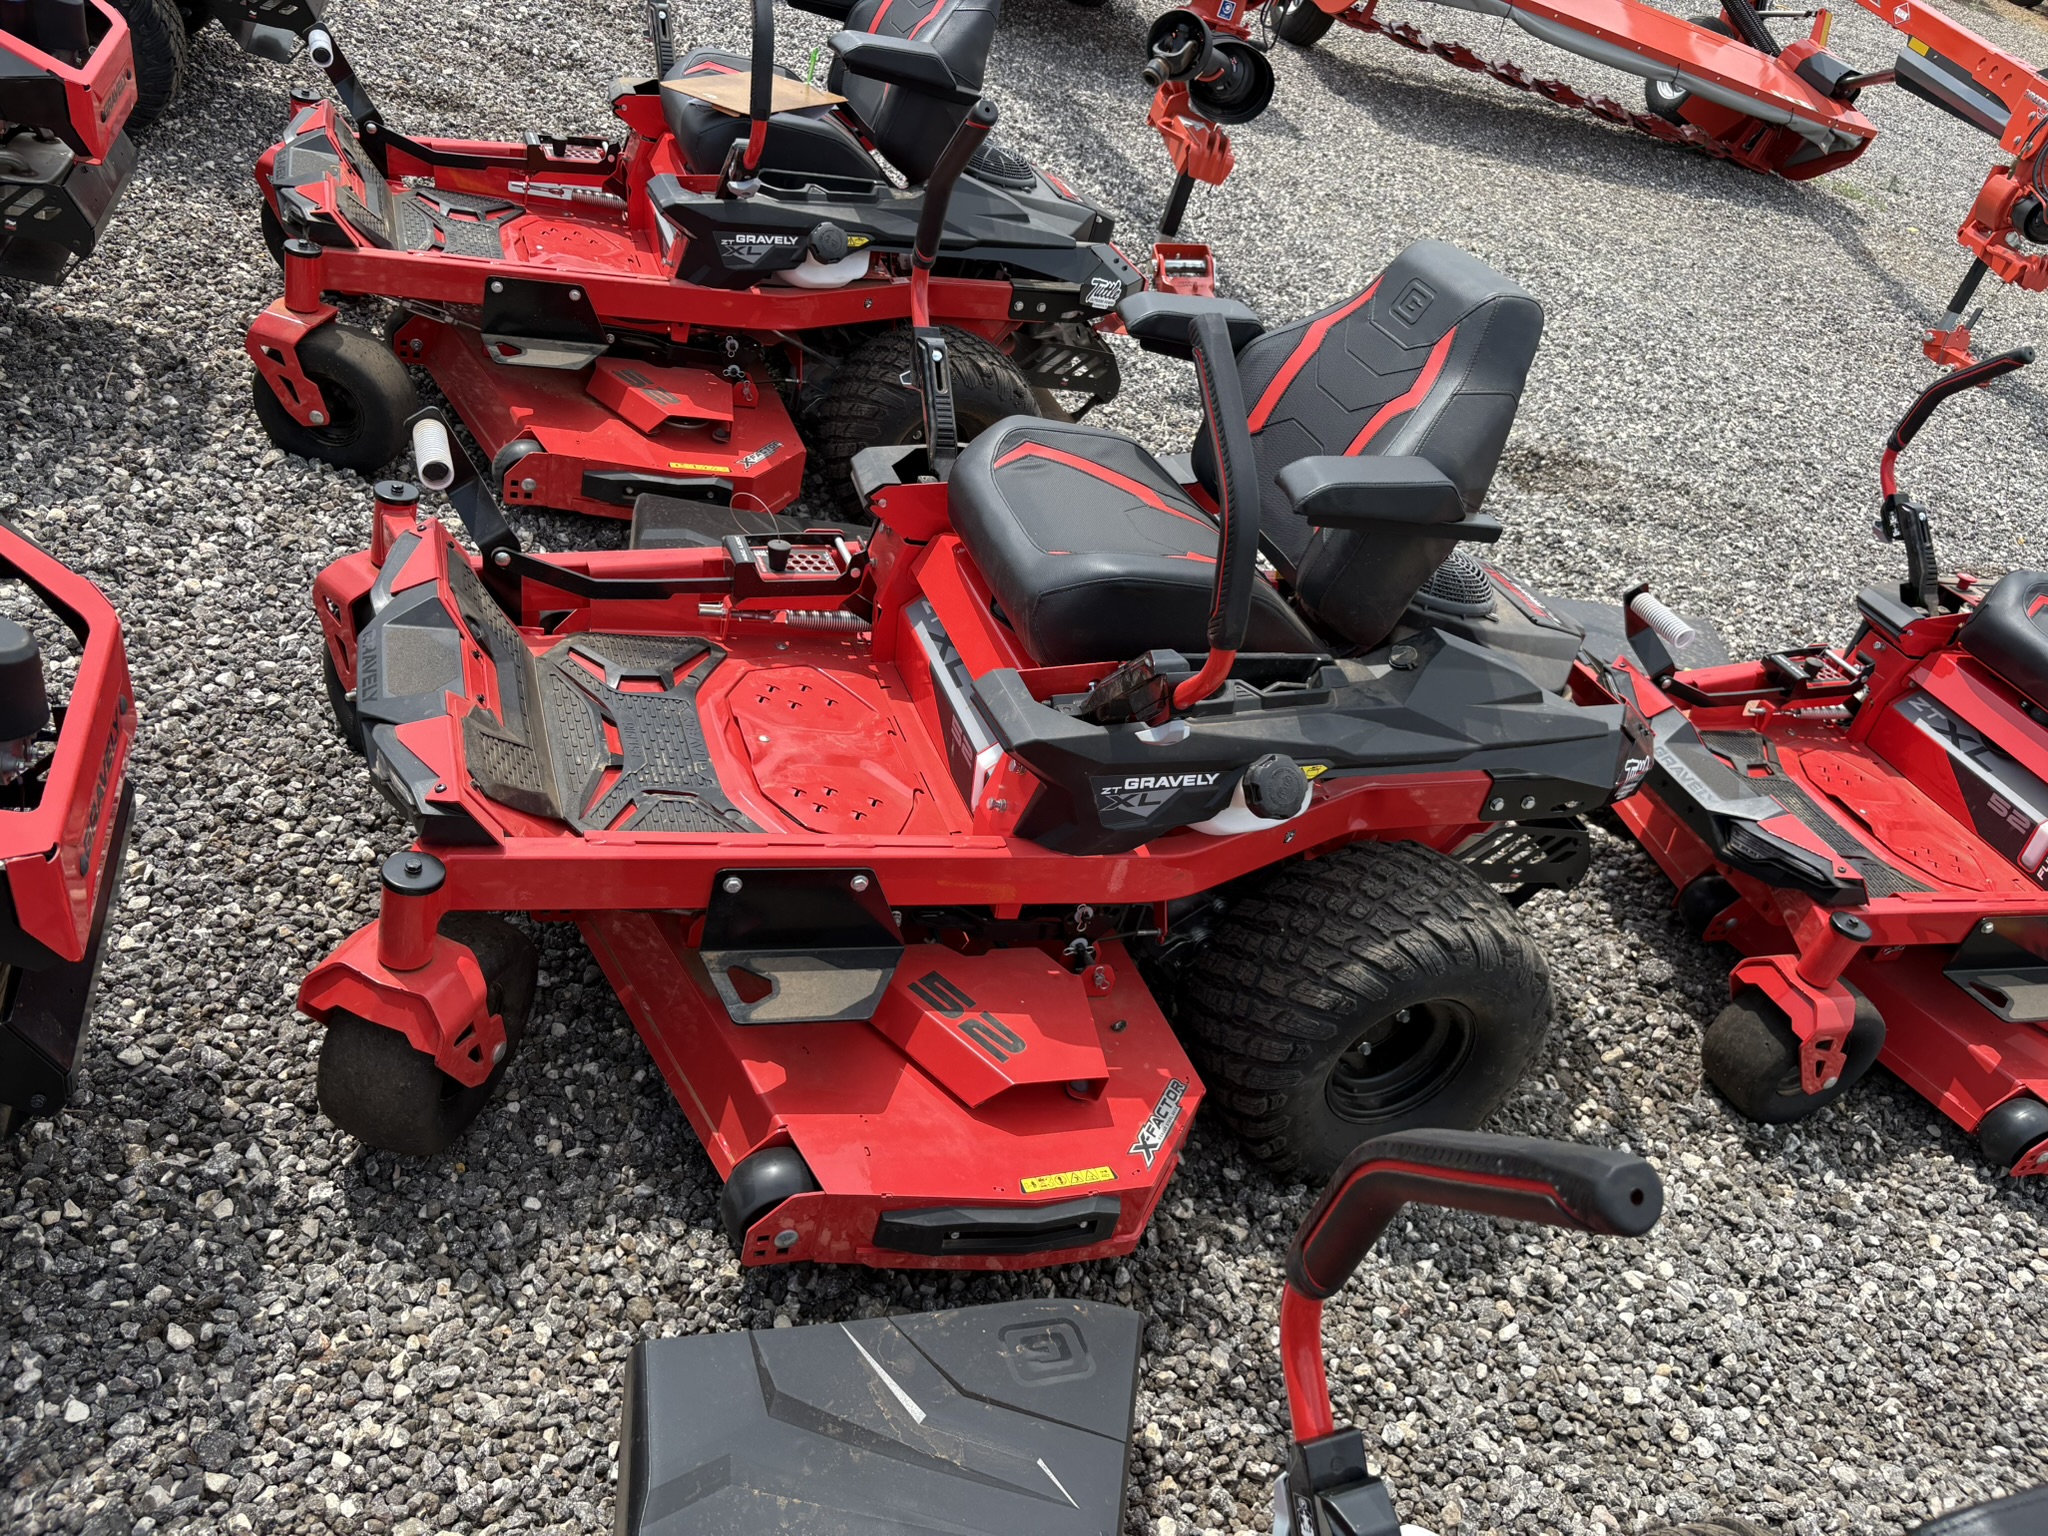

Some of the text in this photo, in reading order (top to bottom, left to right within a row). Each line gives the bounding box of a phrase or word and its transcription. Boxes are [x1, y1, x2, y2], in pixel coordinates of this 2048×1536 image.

[722, 246, 763, 257] XL
[736, 234, 799, 246] GRAVELY
[1086, 278, 1122, 303] Tuttle
[612, 369, 682, 406] 52
[738, 441, 783, 469] X-FACTOR
[362, 630, 379, 703] GRAVELY
[951, 714, 973, 770] 52
[1908, 696, 1994, 773] ZT XL
[1101, 772, 1221, 795] ZT GRAVELY
[1655, 745, 1717, 803] GRAVELY
[1101, 792, 1162, 811] XL
[1987, 792, 2031, 836] 52
[906, 970, 1027, 1064] 52
[1132, 1079, 1185, 1165] X-FACTOR
